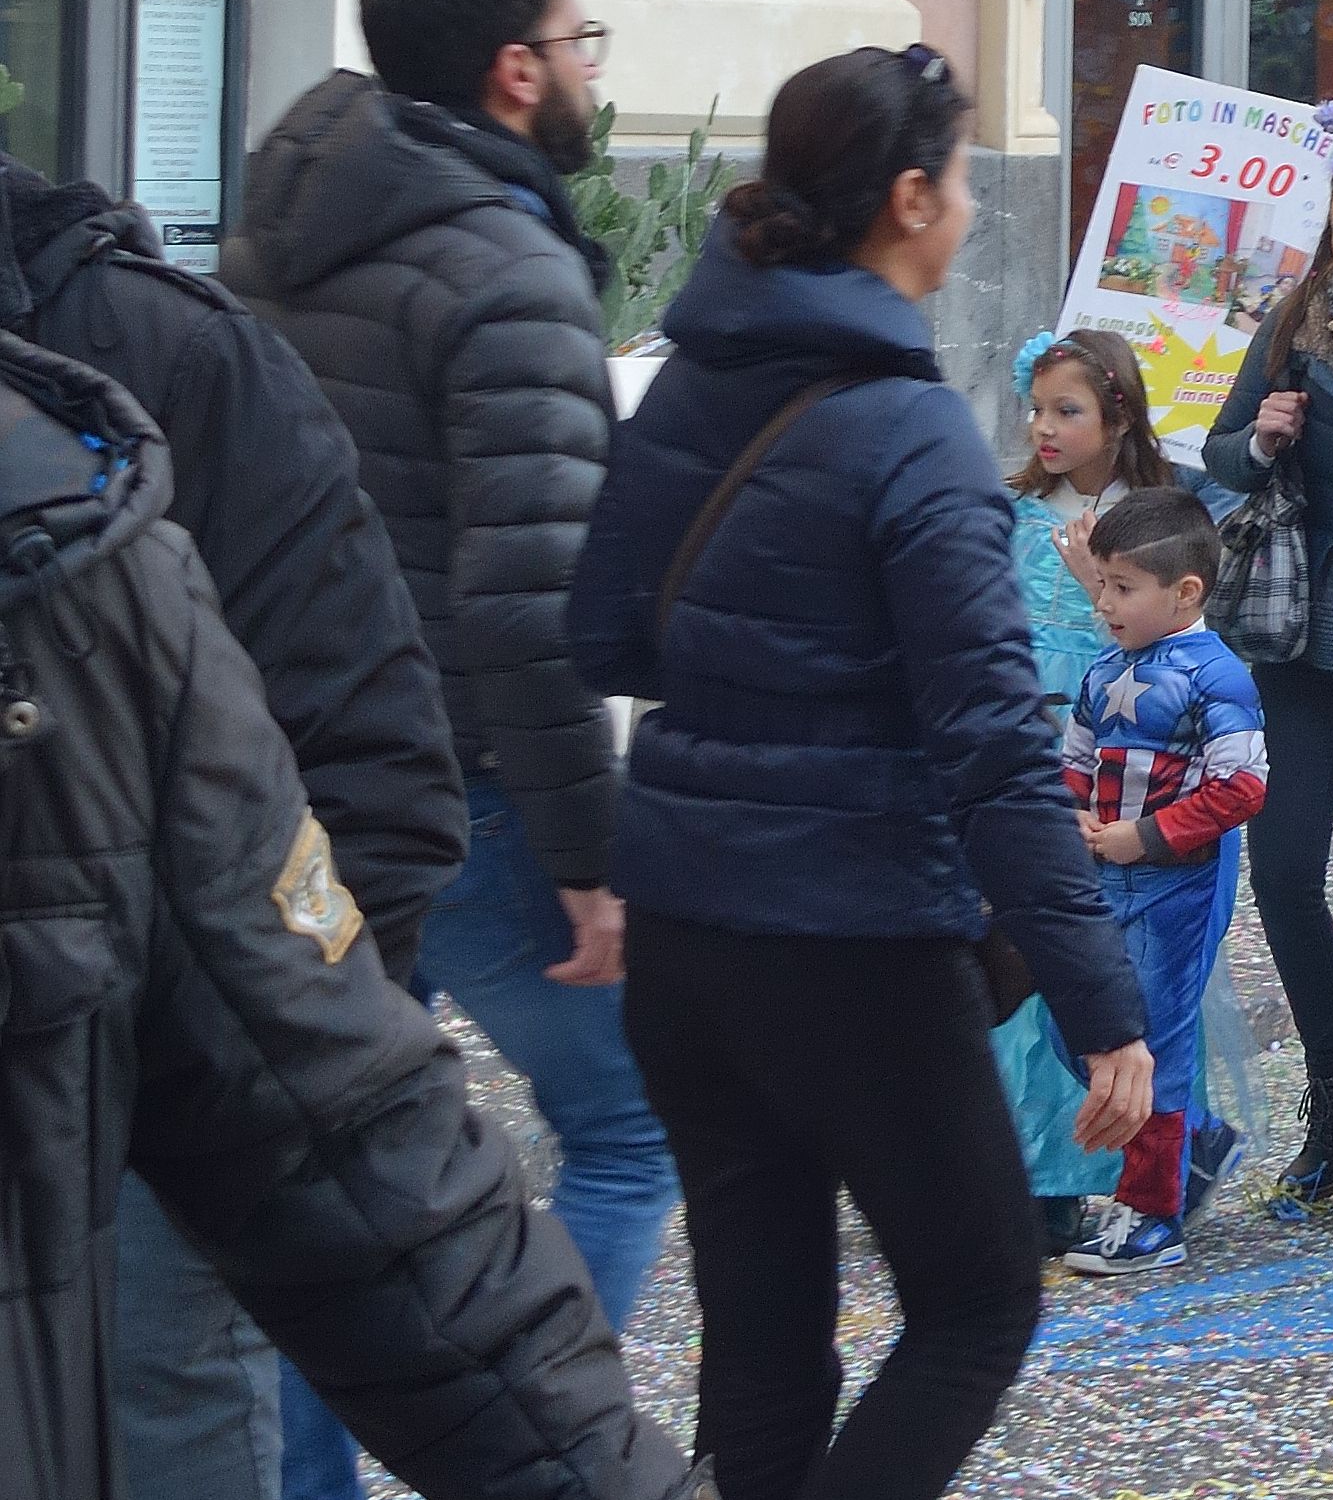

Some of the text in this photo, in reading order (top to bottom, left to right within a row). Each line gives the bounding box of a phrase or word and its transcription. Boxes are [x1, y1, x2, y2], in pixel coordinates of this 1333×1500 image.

[1141, 100, 1203, 127] FOTO
[1210, 101, 1237, 124] IN
[1163, 144, 1298, 197] € 3.00
[1182, 369, 1237, 386] conse
[1174, 386, 1228, 404] imme
